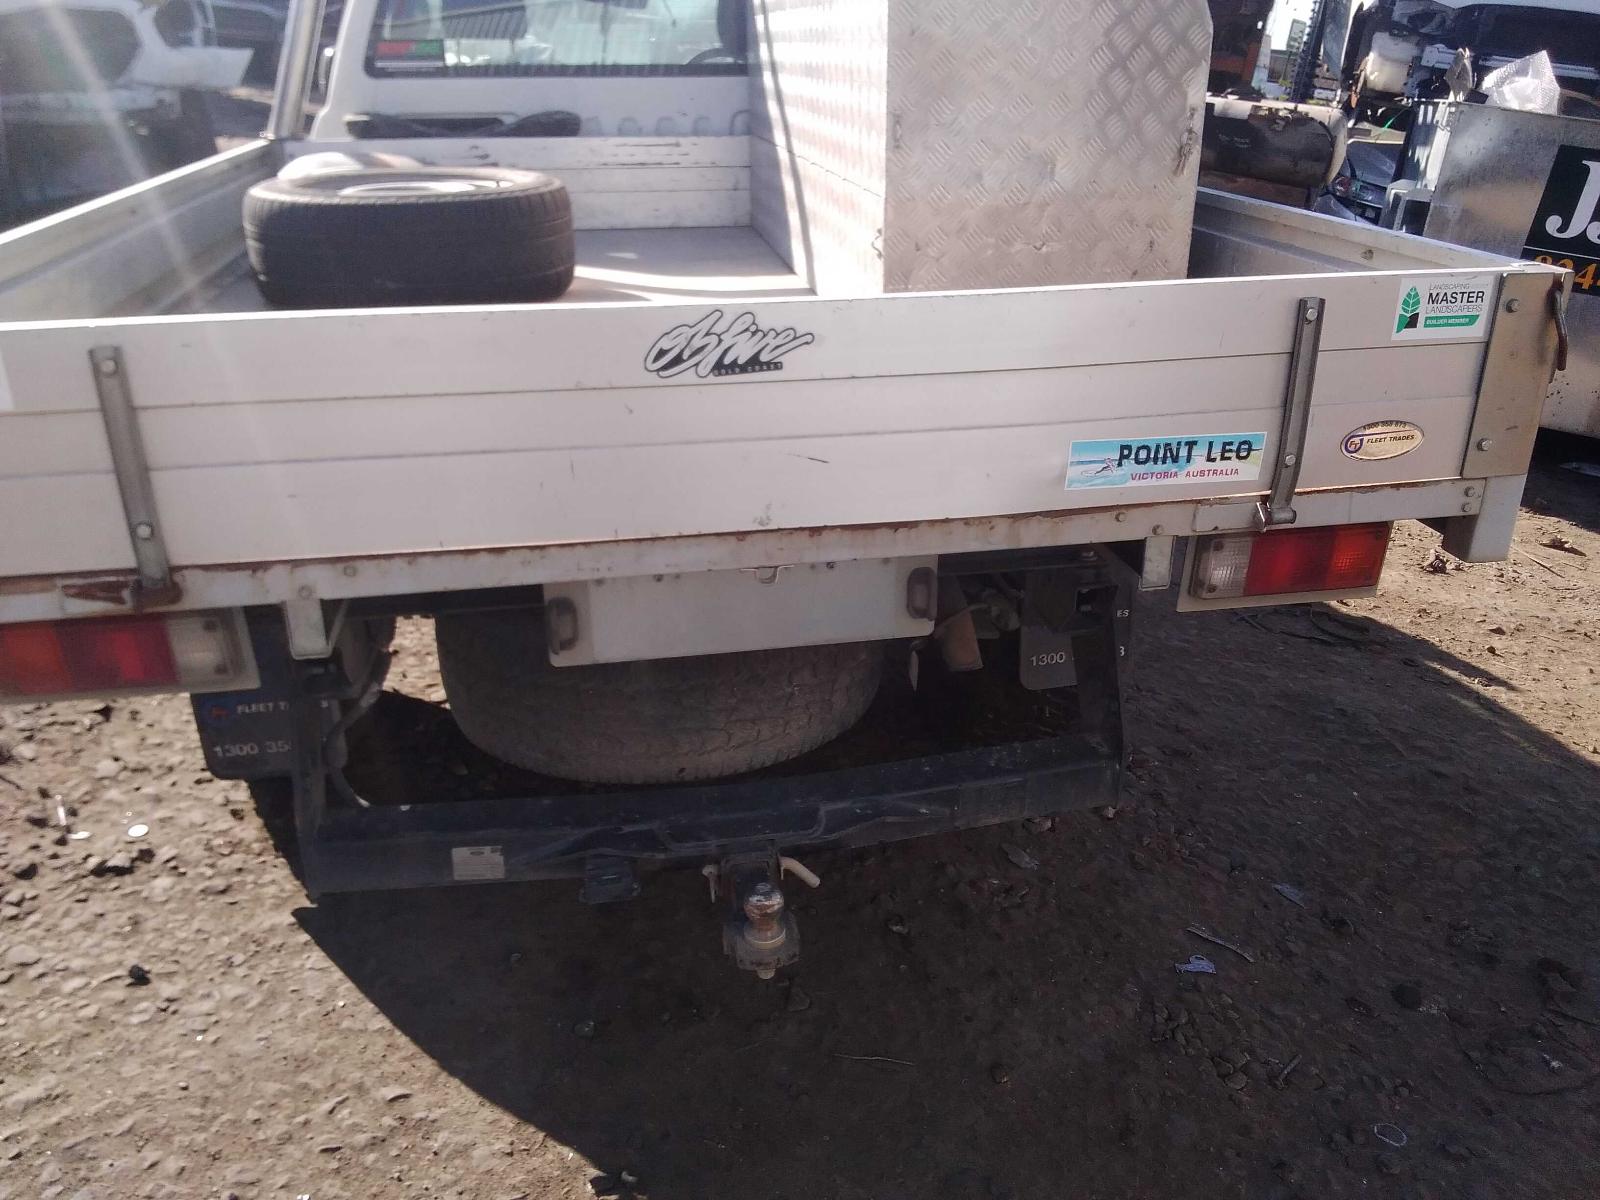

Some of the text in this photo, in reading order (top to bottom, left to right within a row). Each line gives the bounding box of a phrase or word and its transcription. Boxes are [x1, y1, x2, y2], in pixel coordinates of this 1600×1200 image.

[1427, 291, 1485, 305] MASTER
[1425, 304, 1483, 314] LANDSCAPERS
[1388, 434, 1415, 442] TRADES
[1117, 440, 1254, 468] POINT LEO
[1131, 468, 1239, 481] VICTORIA AUSTRALIA
[1030, 651, 1066, 667] 1300
[236, 702, 274, 714] FLEET
[213, 740, 292, 757] 1300 35
